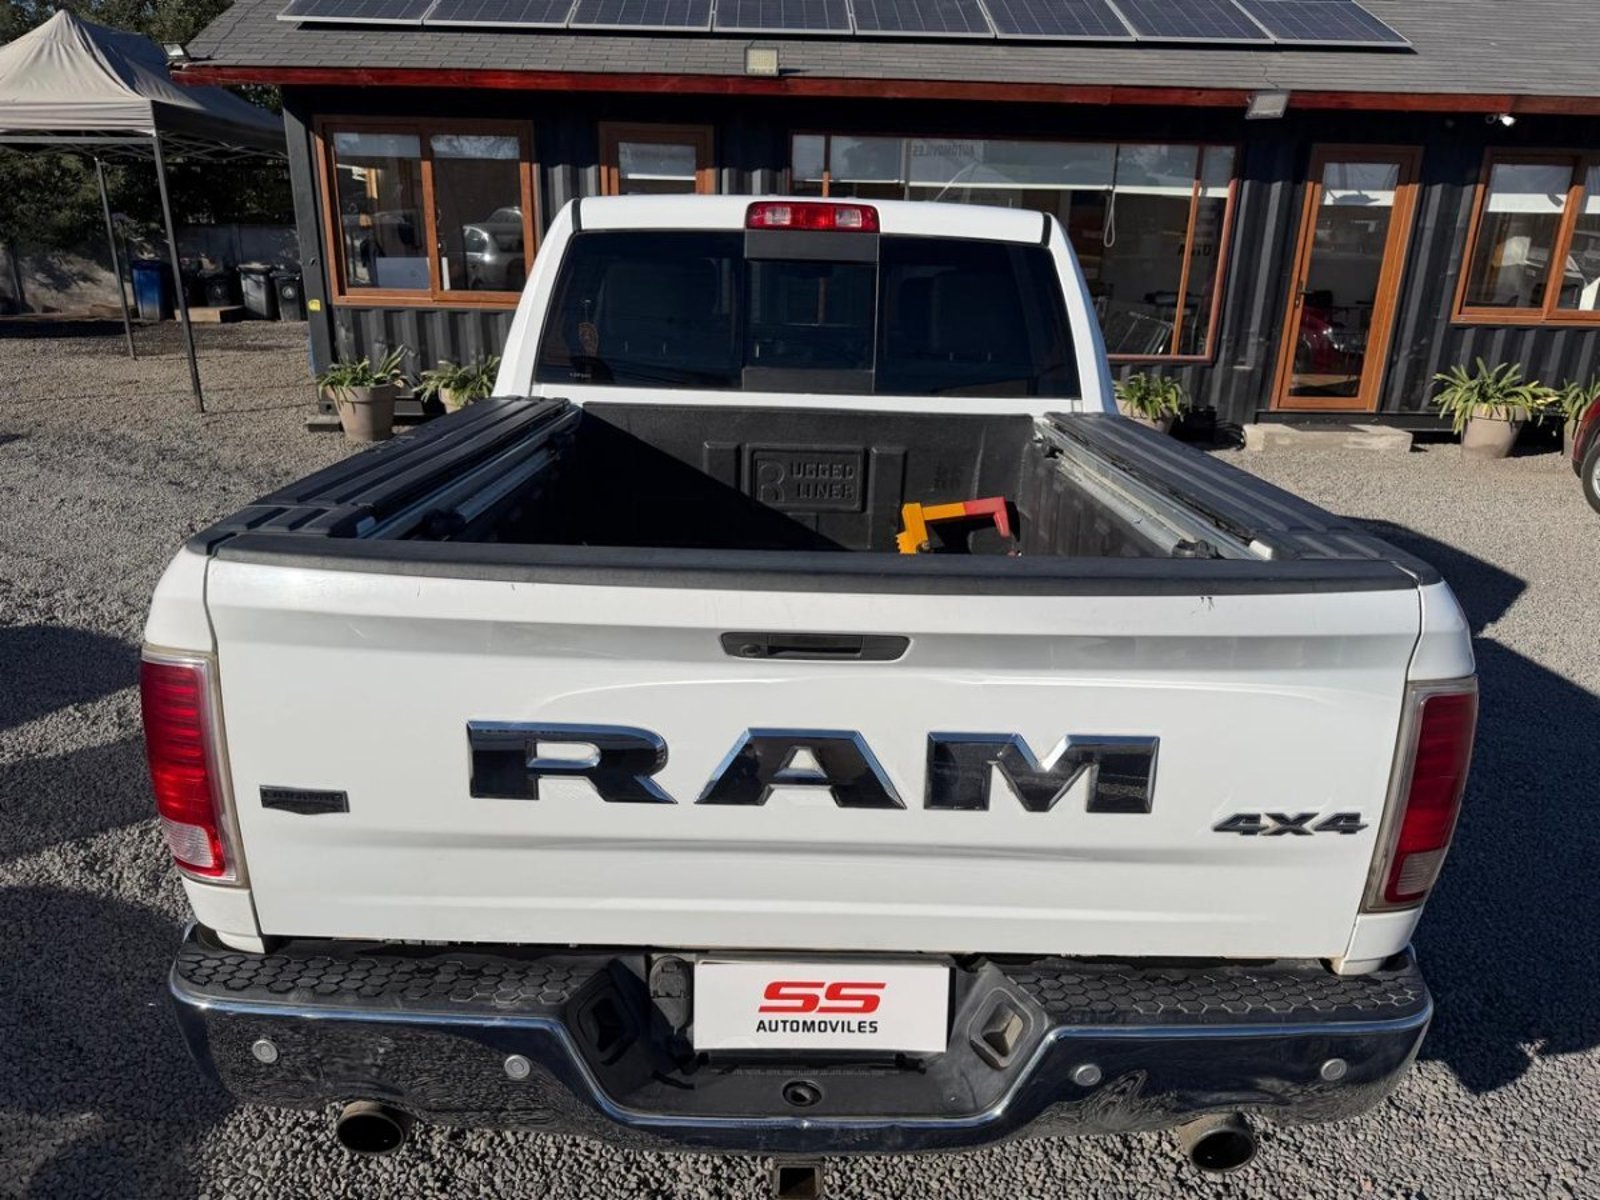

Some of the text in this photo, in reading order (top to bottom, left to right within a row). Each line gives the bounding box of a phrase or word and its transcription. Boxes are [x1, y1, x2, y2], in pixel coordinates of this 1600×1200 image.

[466, 719, 1160, 814] RAM
[757, 981, 887, 1014] SS
[756, 1019, 879, 1034] AUTOMOVILES
